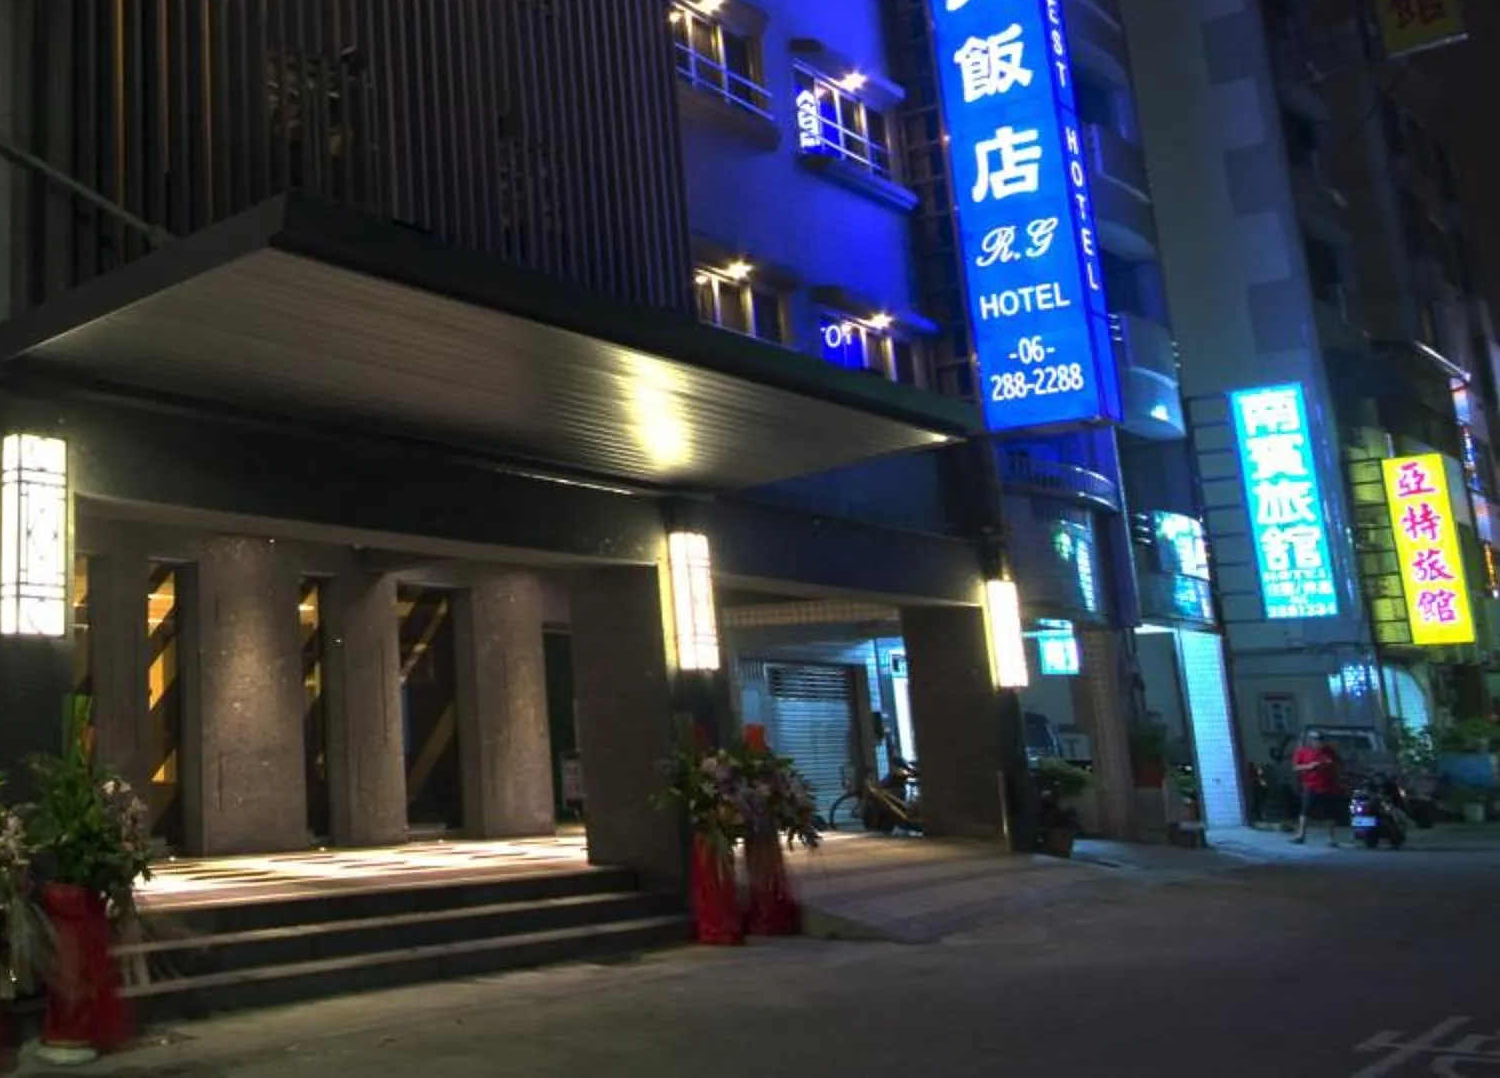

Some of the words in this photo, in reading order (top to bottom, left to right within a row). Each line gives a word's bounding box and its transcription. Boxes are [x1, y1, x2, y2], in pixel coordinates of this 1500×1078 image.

[1065, 126, 1099, 290] HOTEL
[979, 282, 1070, 320] HOTEL
[991, 362, 1084, 401] 288-2288
[1397, 461, 1457, 622] 亞特旅館
